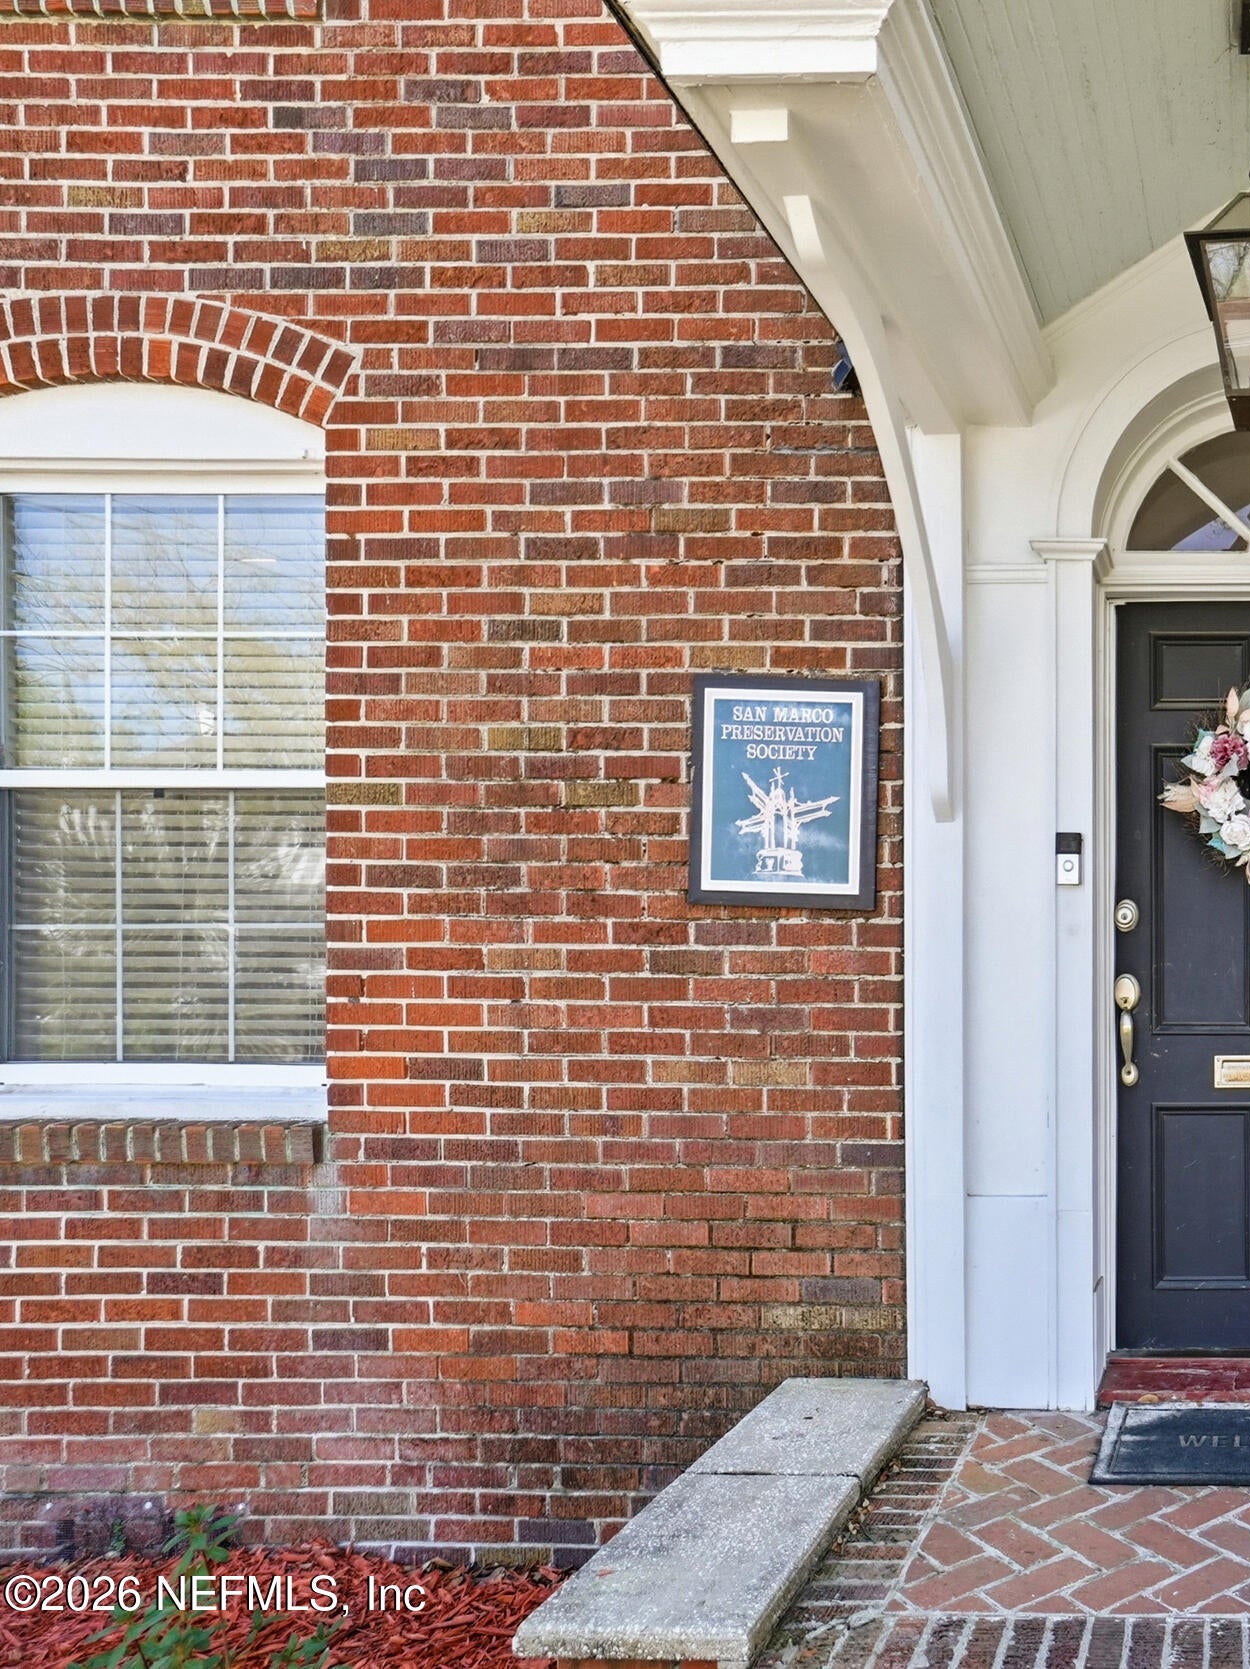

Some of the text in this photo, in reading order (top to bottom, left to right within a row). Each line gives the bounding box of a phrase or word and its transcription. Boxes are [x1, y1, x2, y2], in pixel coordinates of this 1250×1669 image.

[732, 706, 833, 724] SAN MARCO
[721, 724, 843, 742] PRESERVATION
[746, 744, 817, 760] SOCIETY
